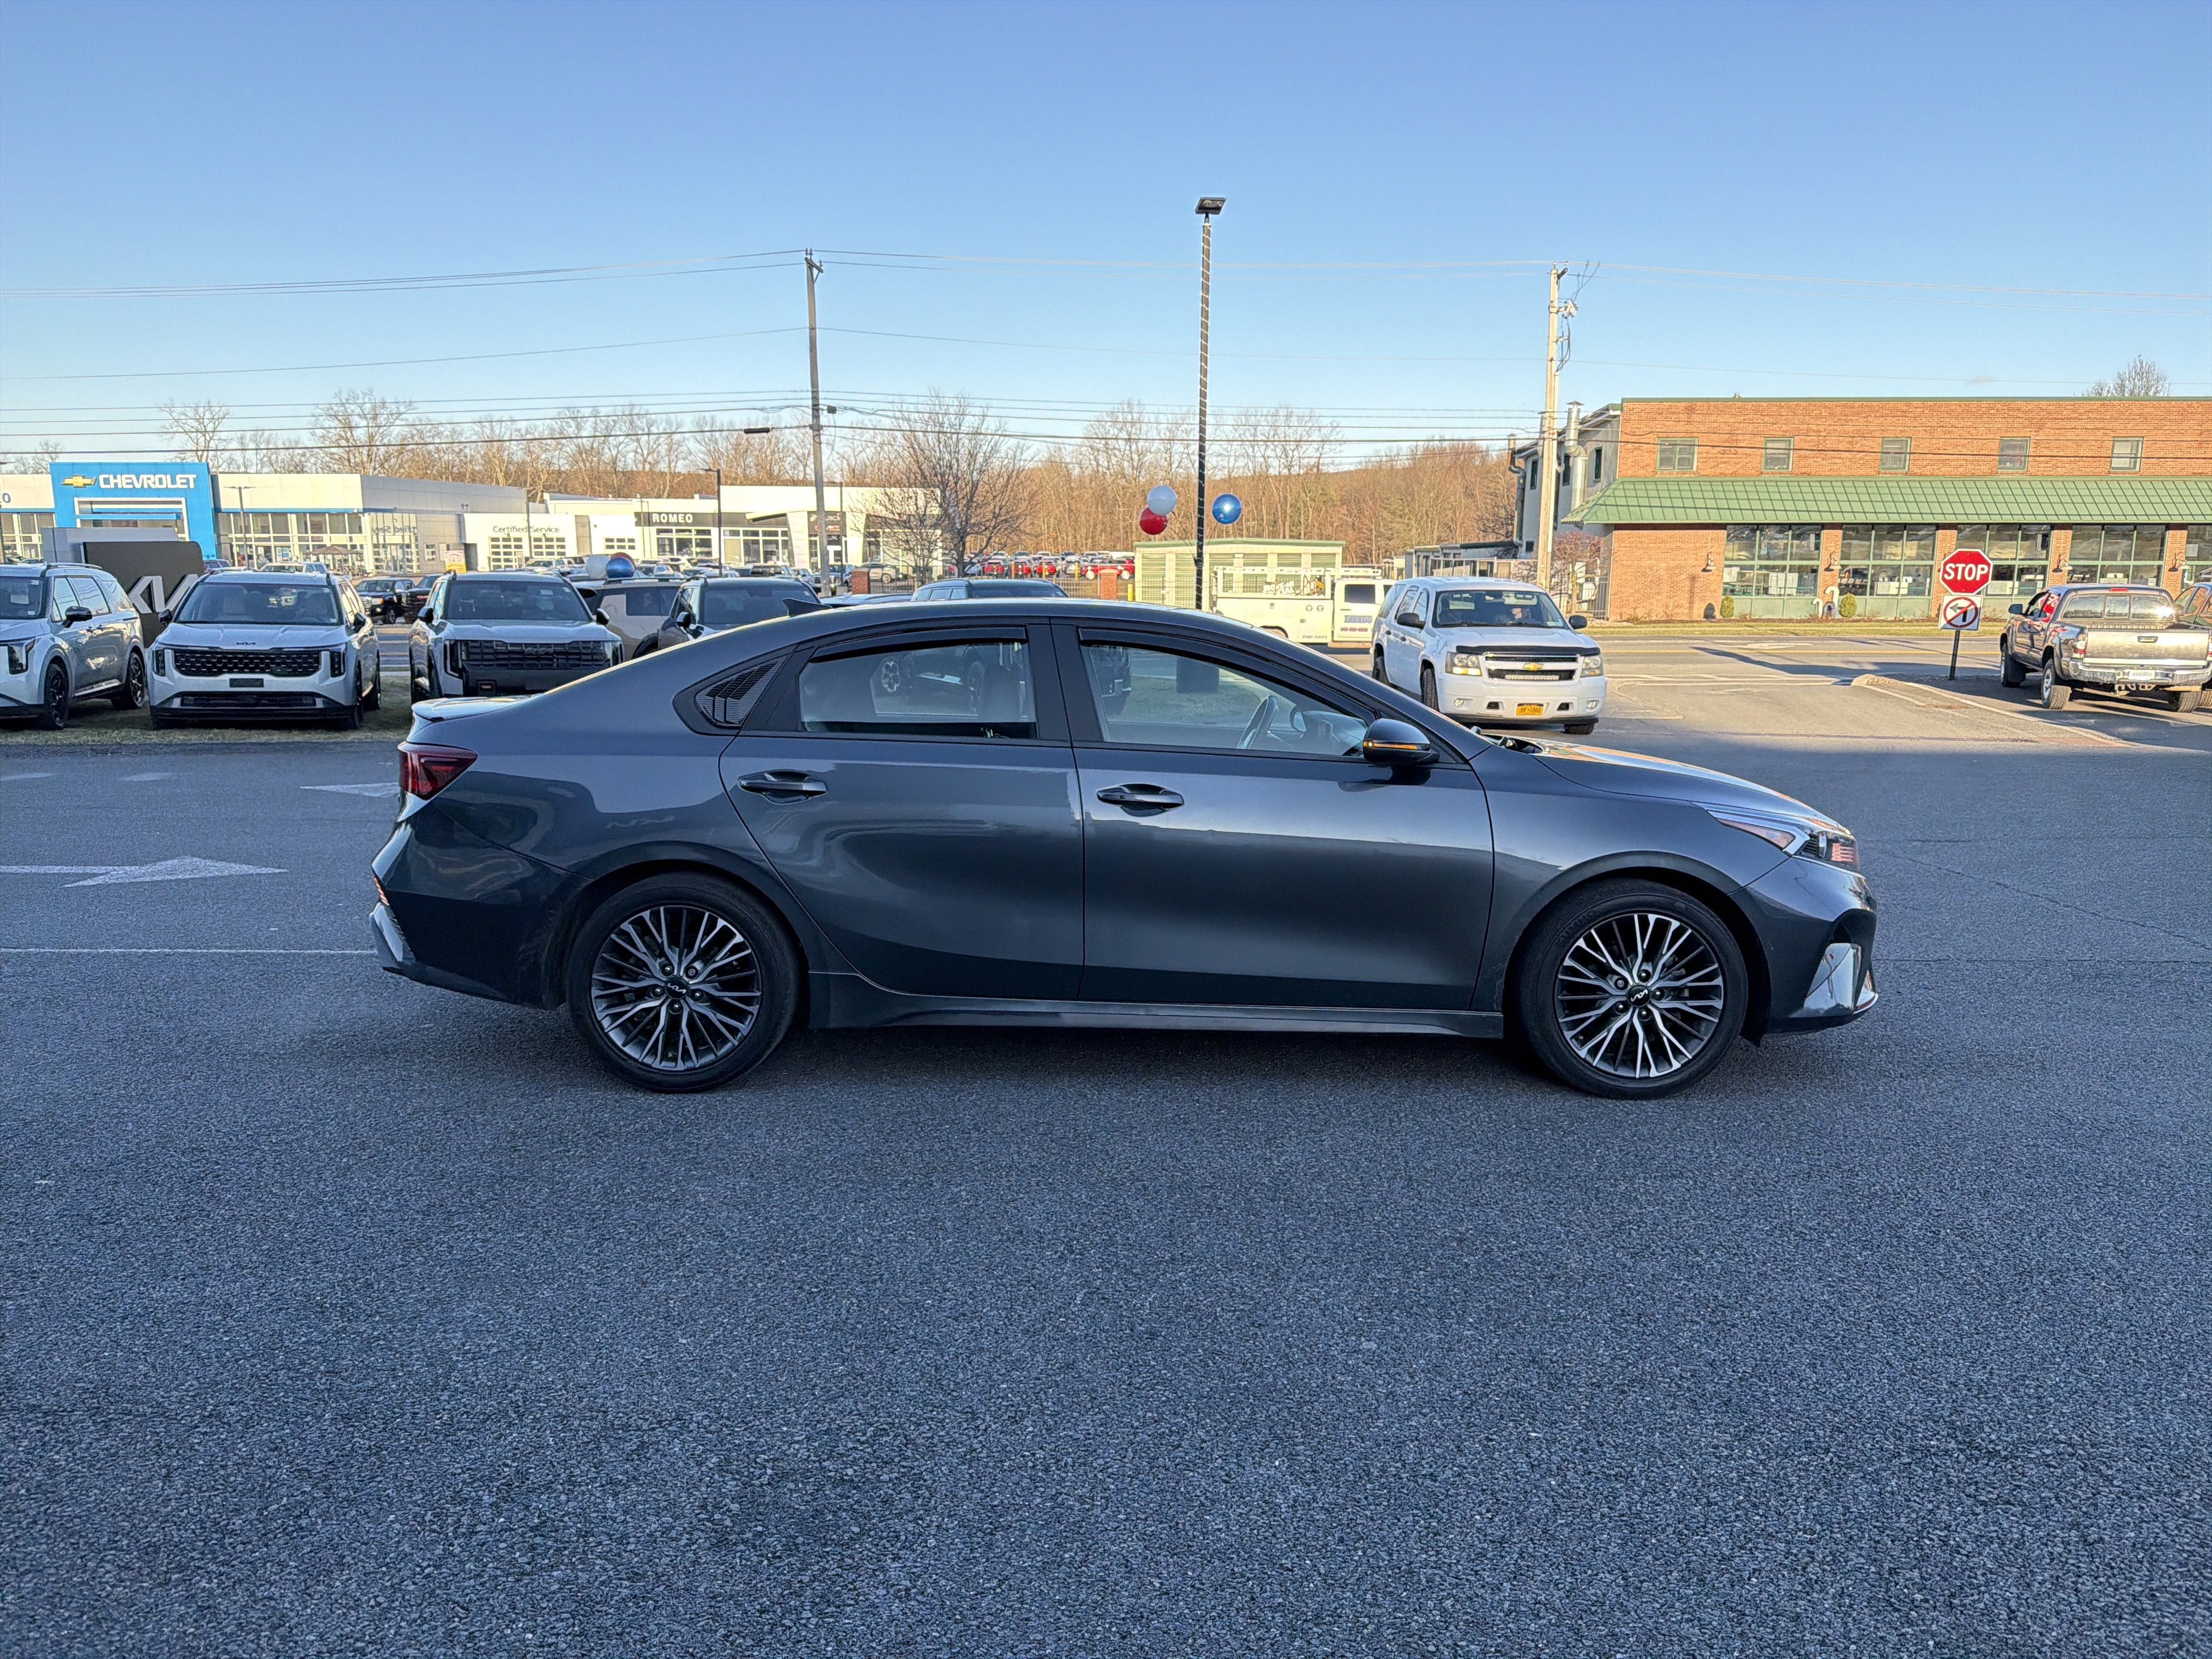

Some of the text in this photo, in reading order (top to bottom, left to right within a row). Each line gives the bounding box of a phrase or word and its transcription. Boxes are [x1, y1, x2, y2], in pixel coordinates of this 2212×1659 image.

[99, 474, 197, 488] CHEVROLET
[652, 514, 693, 523] ROMEO
[1944, 563, 1989, 581] STOP
